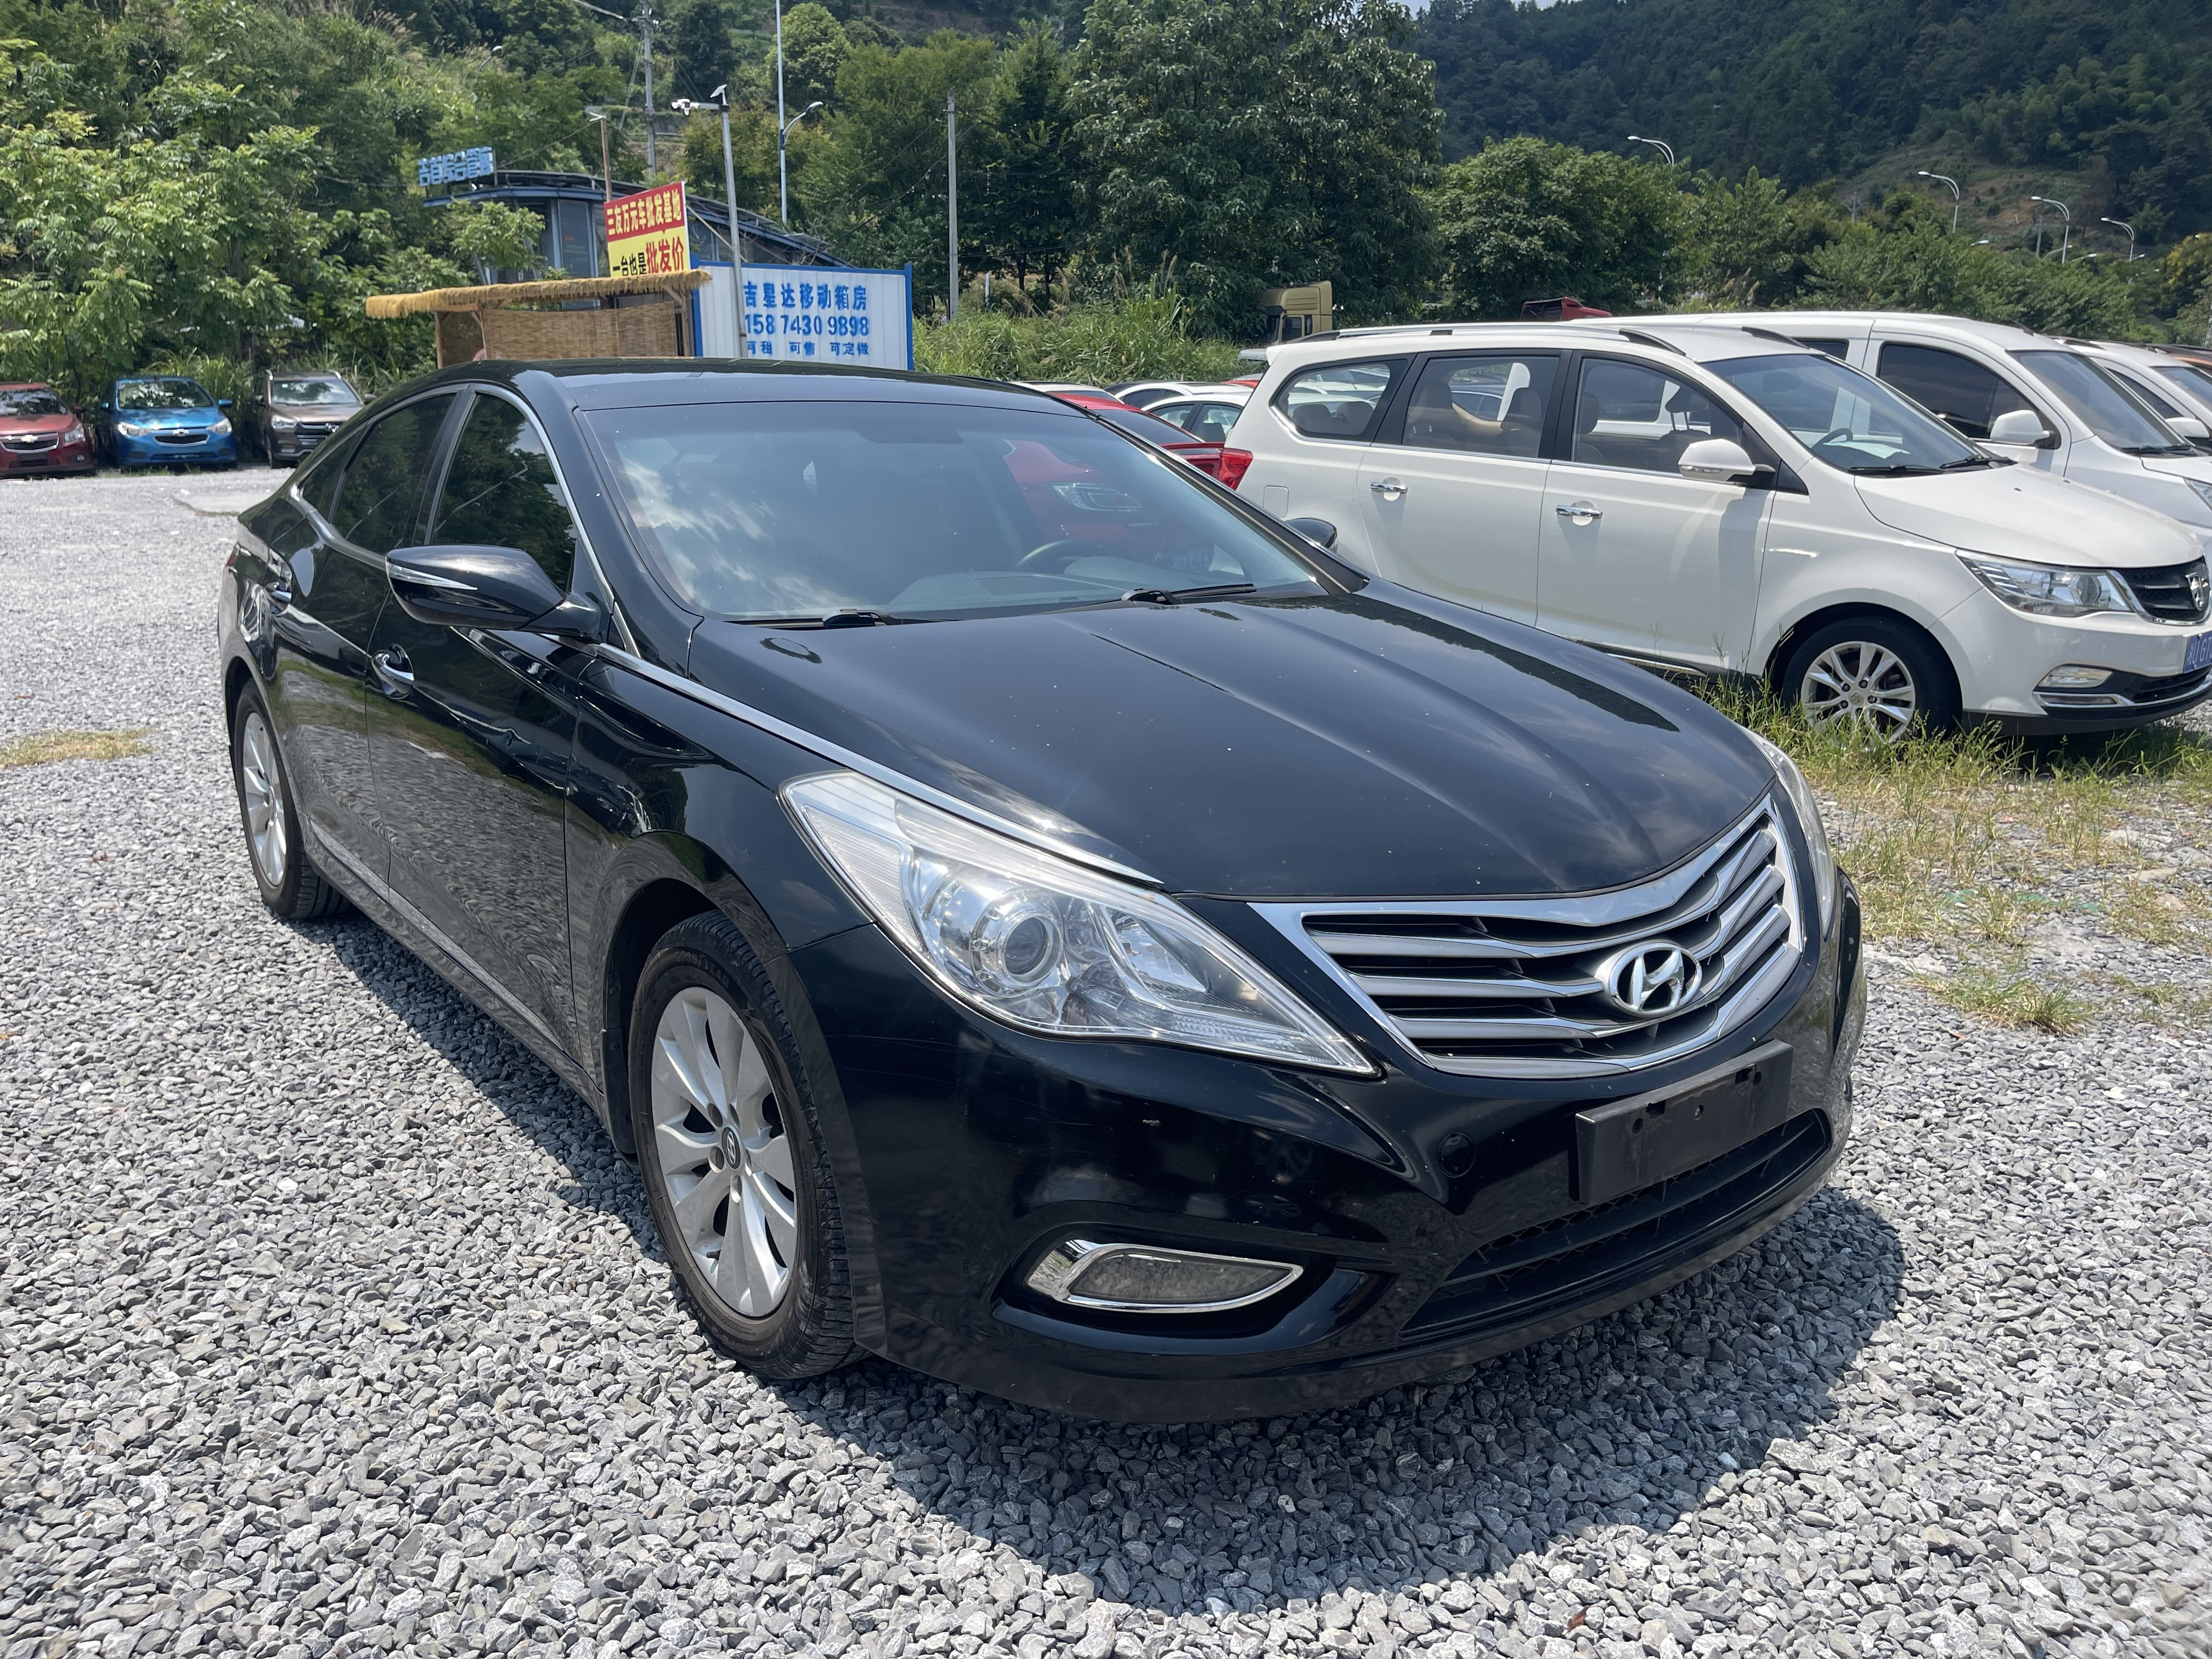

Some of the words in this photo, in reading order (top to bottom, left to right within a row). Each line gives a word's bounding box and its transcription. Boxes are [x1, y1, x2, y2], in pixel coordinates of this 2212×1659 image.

[607, 188, 681, 236] 三友万元车批发基地
[743, 281, 867, 311] 吉星达移动箱房
